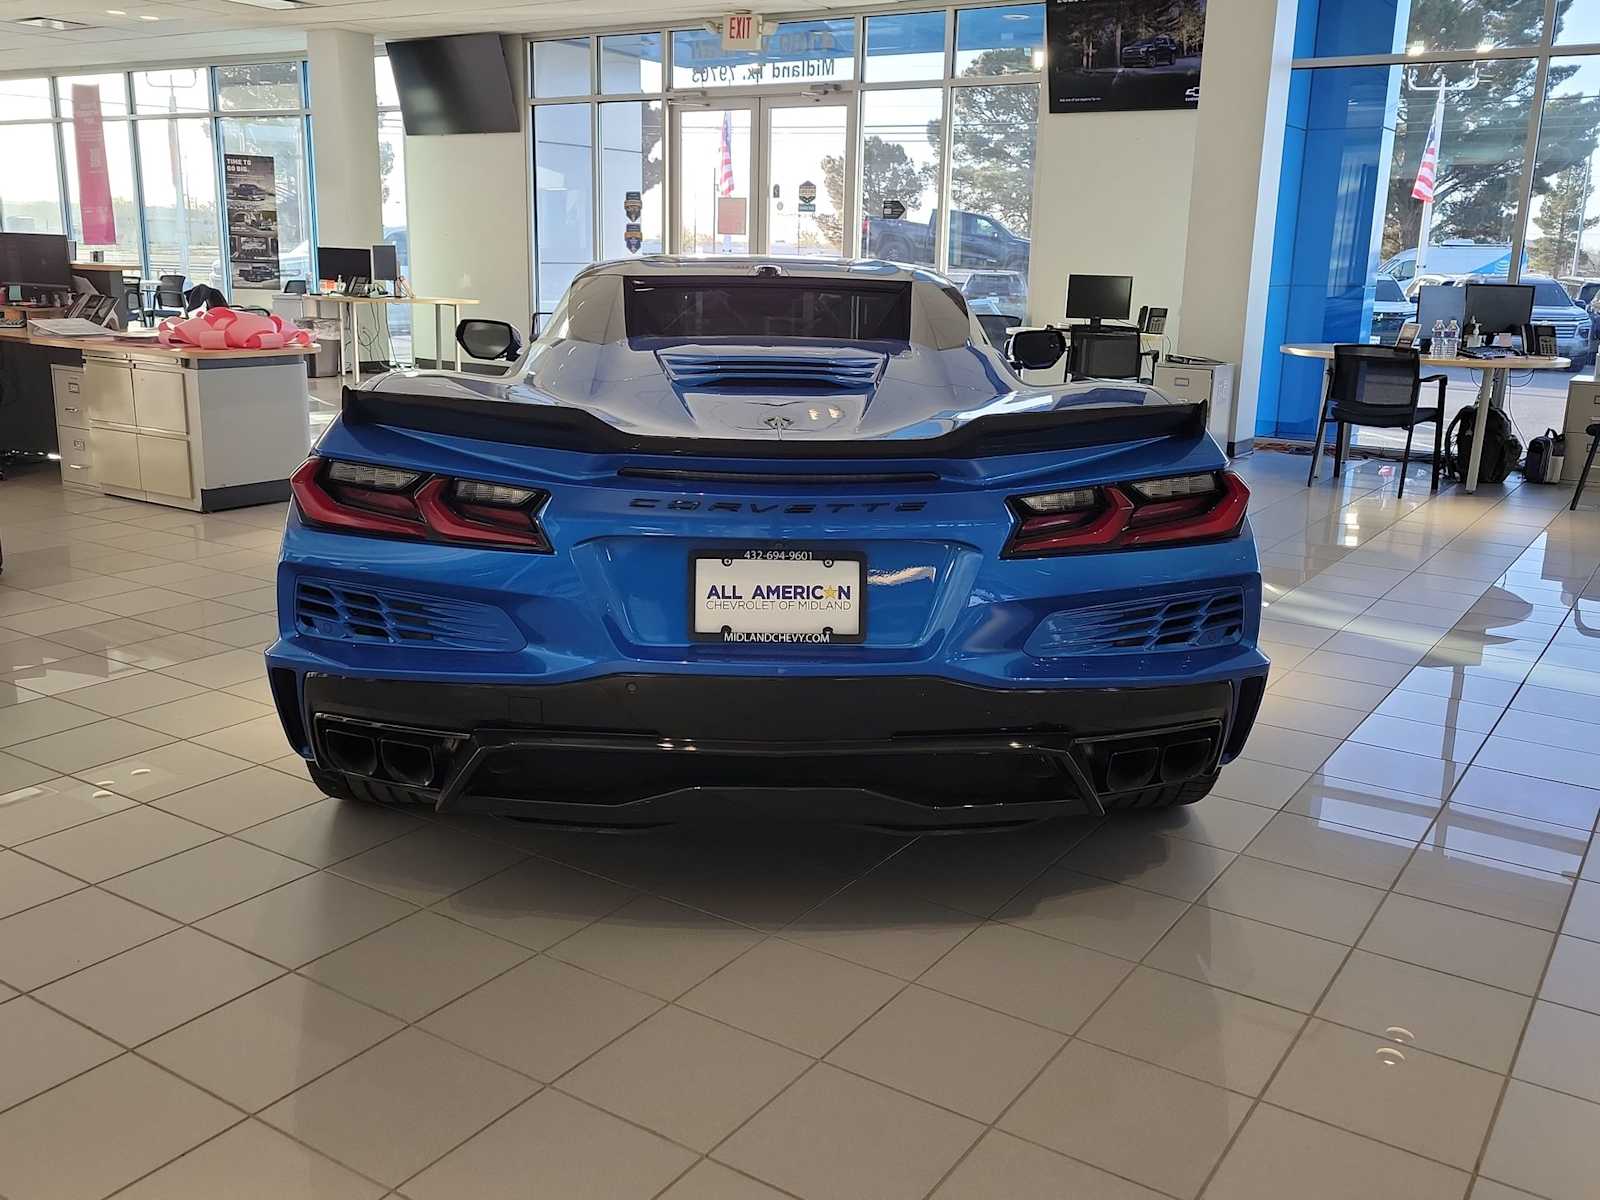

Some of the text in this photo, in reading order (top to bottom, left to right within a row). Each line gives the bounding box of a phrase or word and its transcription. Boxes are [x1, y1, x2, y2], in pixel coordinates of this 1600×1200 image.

[729, 16, 752, 39] EXIT
[628, 498, 928, 514] CORVETTE
[744, 550, 813, 561] 432-694-9601
[707, 585, 743, 600] ALL
[705, 600, 852, 611] CHEVROLET OF MIDLAND
[724, 631, 831, 644] MIDLANDCHEVY.COM
